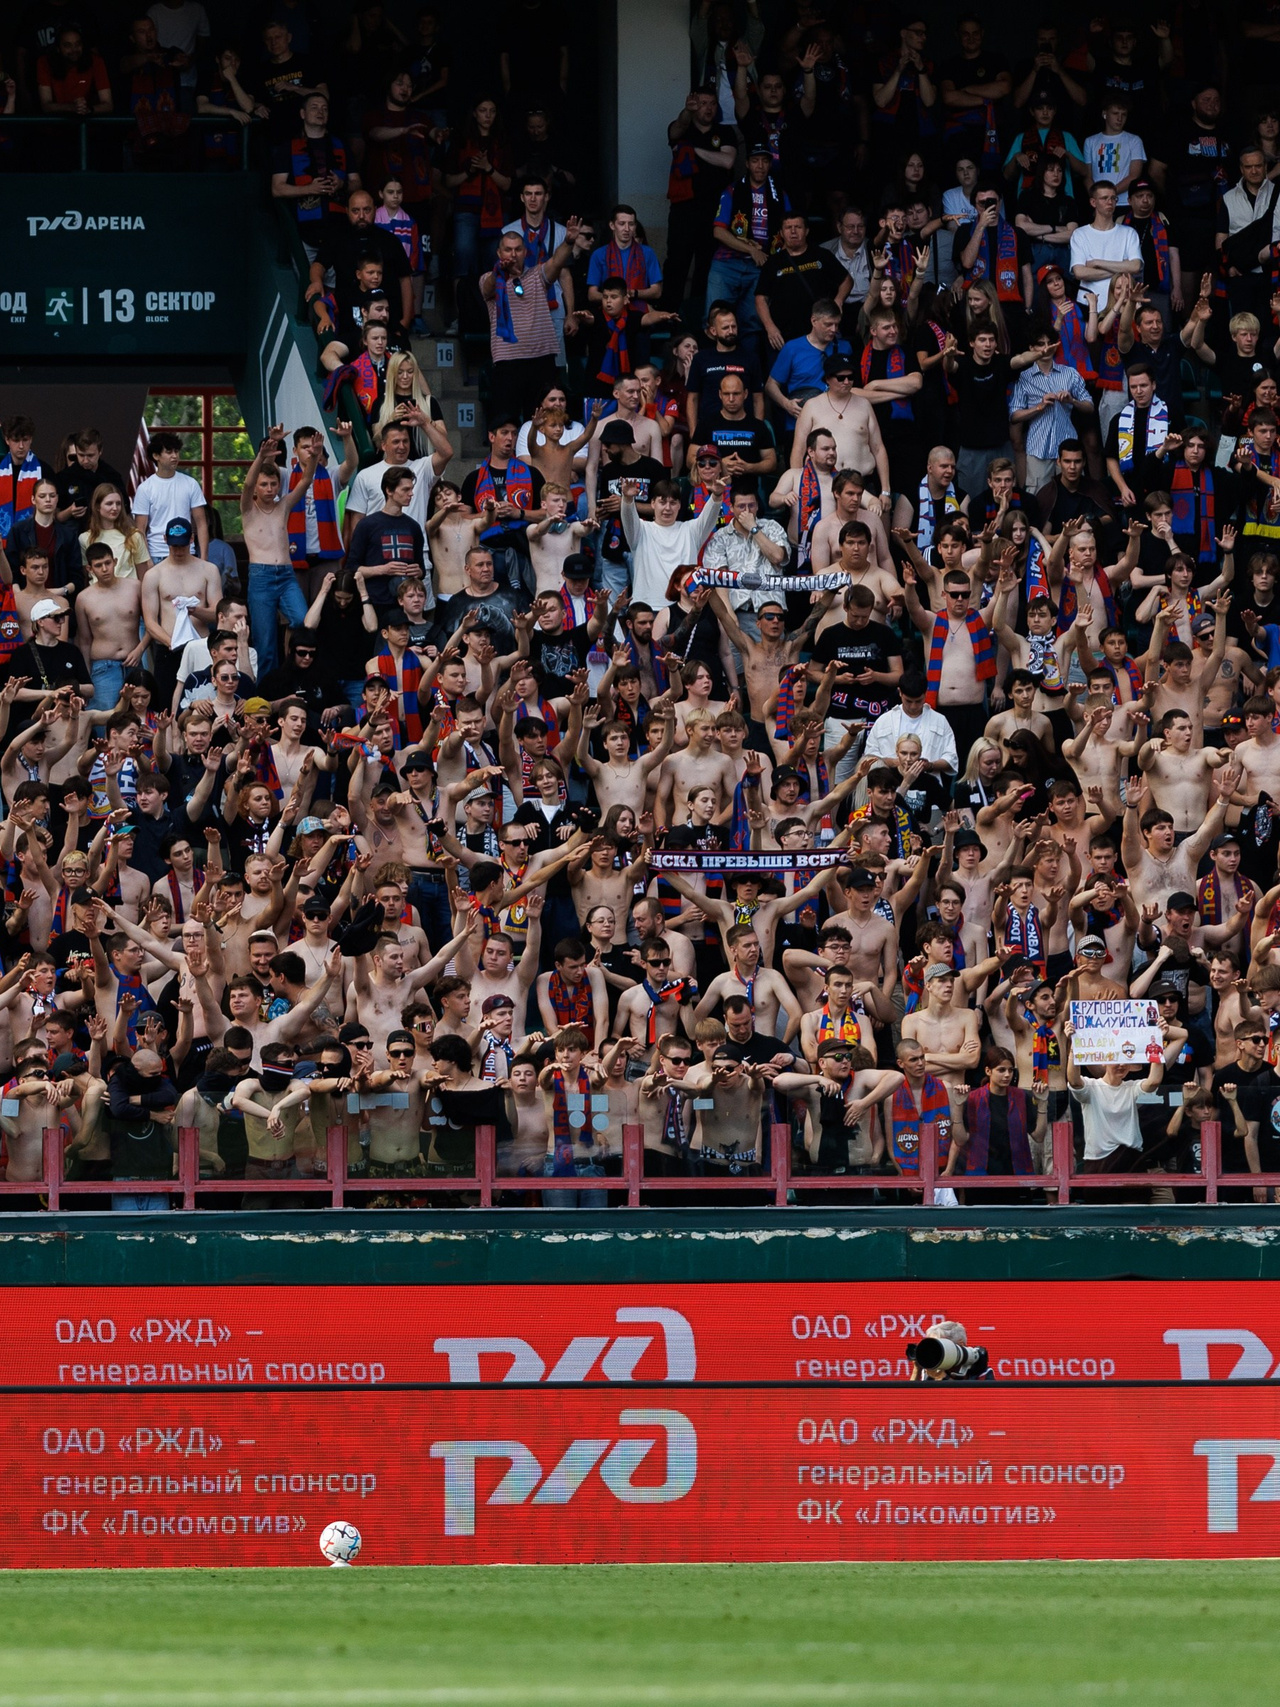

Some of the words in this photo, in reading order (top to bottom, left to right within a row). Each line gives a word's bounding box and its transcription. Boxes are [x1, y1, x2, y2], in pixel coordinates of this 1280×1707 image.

[85, 216, 145, 230] АРЕНА
[98, 289, 135, 322] 13
[145, 291, 216, 311] СЕКТОР
[426, 291, 433, 303] 7
[438, 349, 452, 362] 16
[458, 409, 473, 422] 15
[693, 568, 734, 587] CSKA
[702, 855, 793, 867] ПРЕВЫШЕ
[56, 1319, 117, 1343] ОАО
[129, 1319, 232, 1347] «РЖД»
[792, 1315, 851, 1340] ОАО
[59, 1358, 253, 1385] генеральный
[265, 1362, 386, 1384] спонсор
[796, 1358, 910, 1381] генерал
[998, 1358, 1116, 1380] спонсор
[43, 1428, 105, 1454] ОАО
[119, 1427, 223, 1457] «РЖД»
[797, 1418, 858, 1444] ОАО
[872, 1418, 974, 1448] «РЖД»
[43, 1469, 242, 1501] генеральный
[254, 1473, 377, 1498] спонсор
[797, 1460, 993, 1490] генеральный
[1005, 1464, 1125, 1489] спонсор
[42, 1509, 90, 1535] ФК
[102, 1509, 307, 1535] «Локомотив»
[797, 1499, 843, 1524] ФК
[855, 1500, 1057, 1524] «Локомотив»
